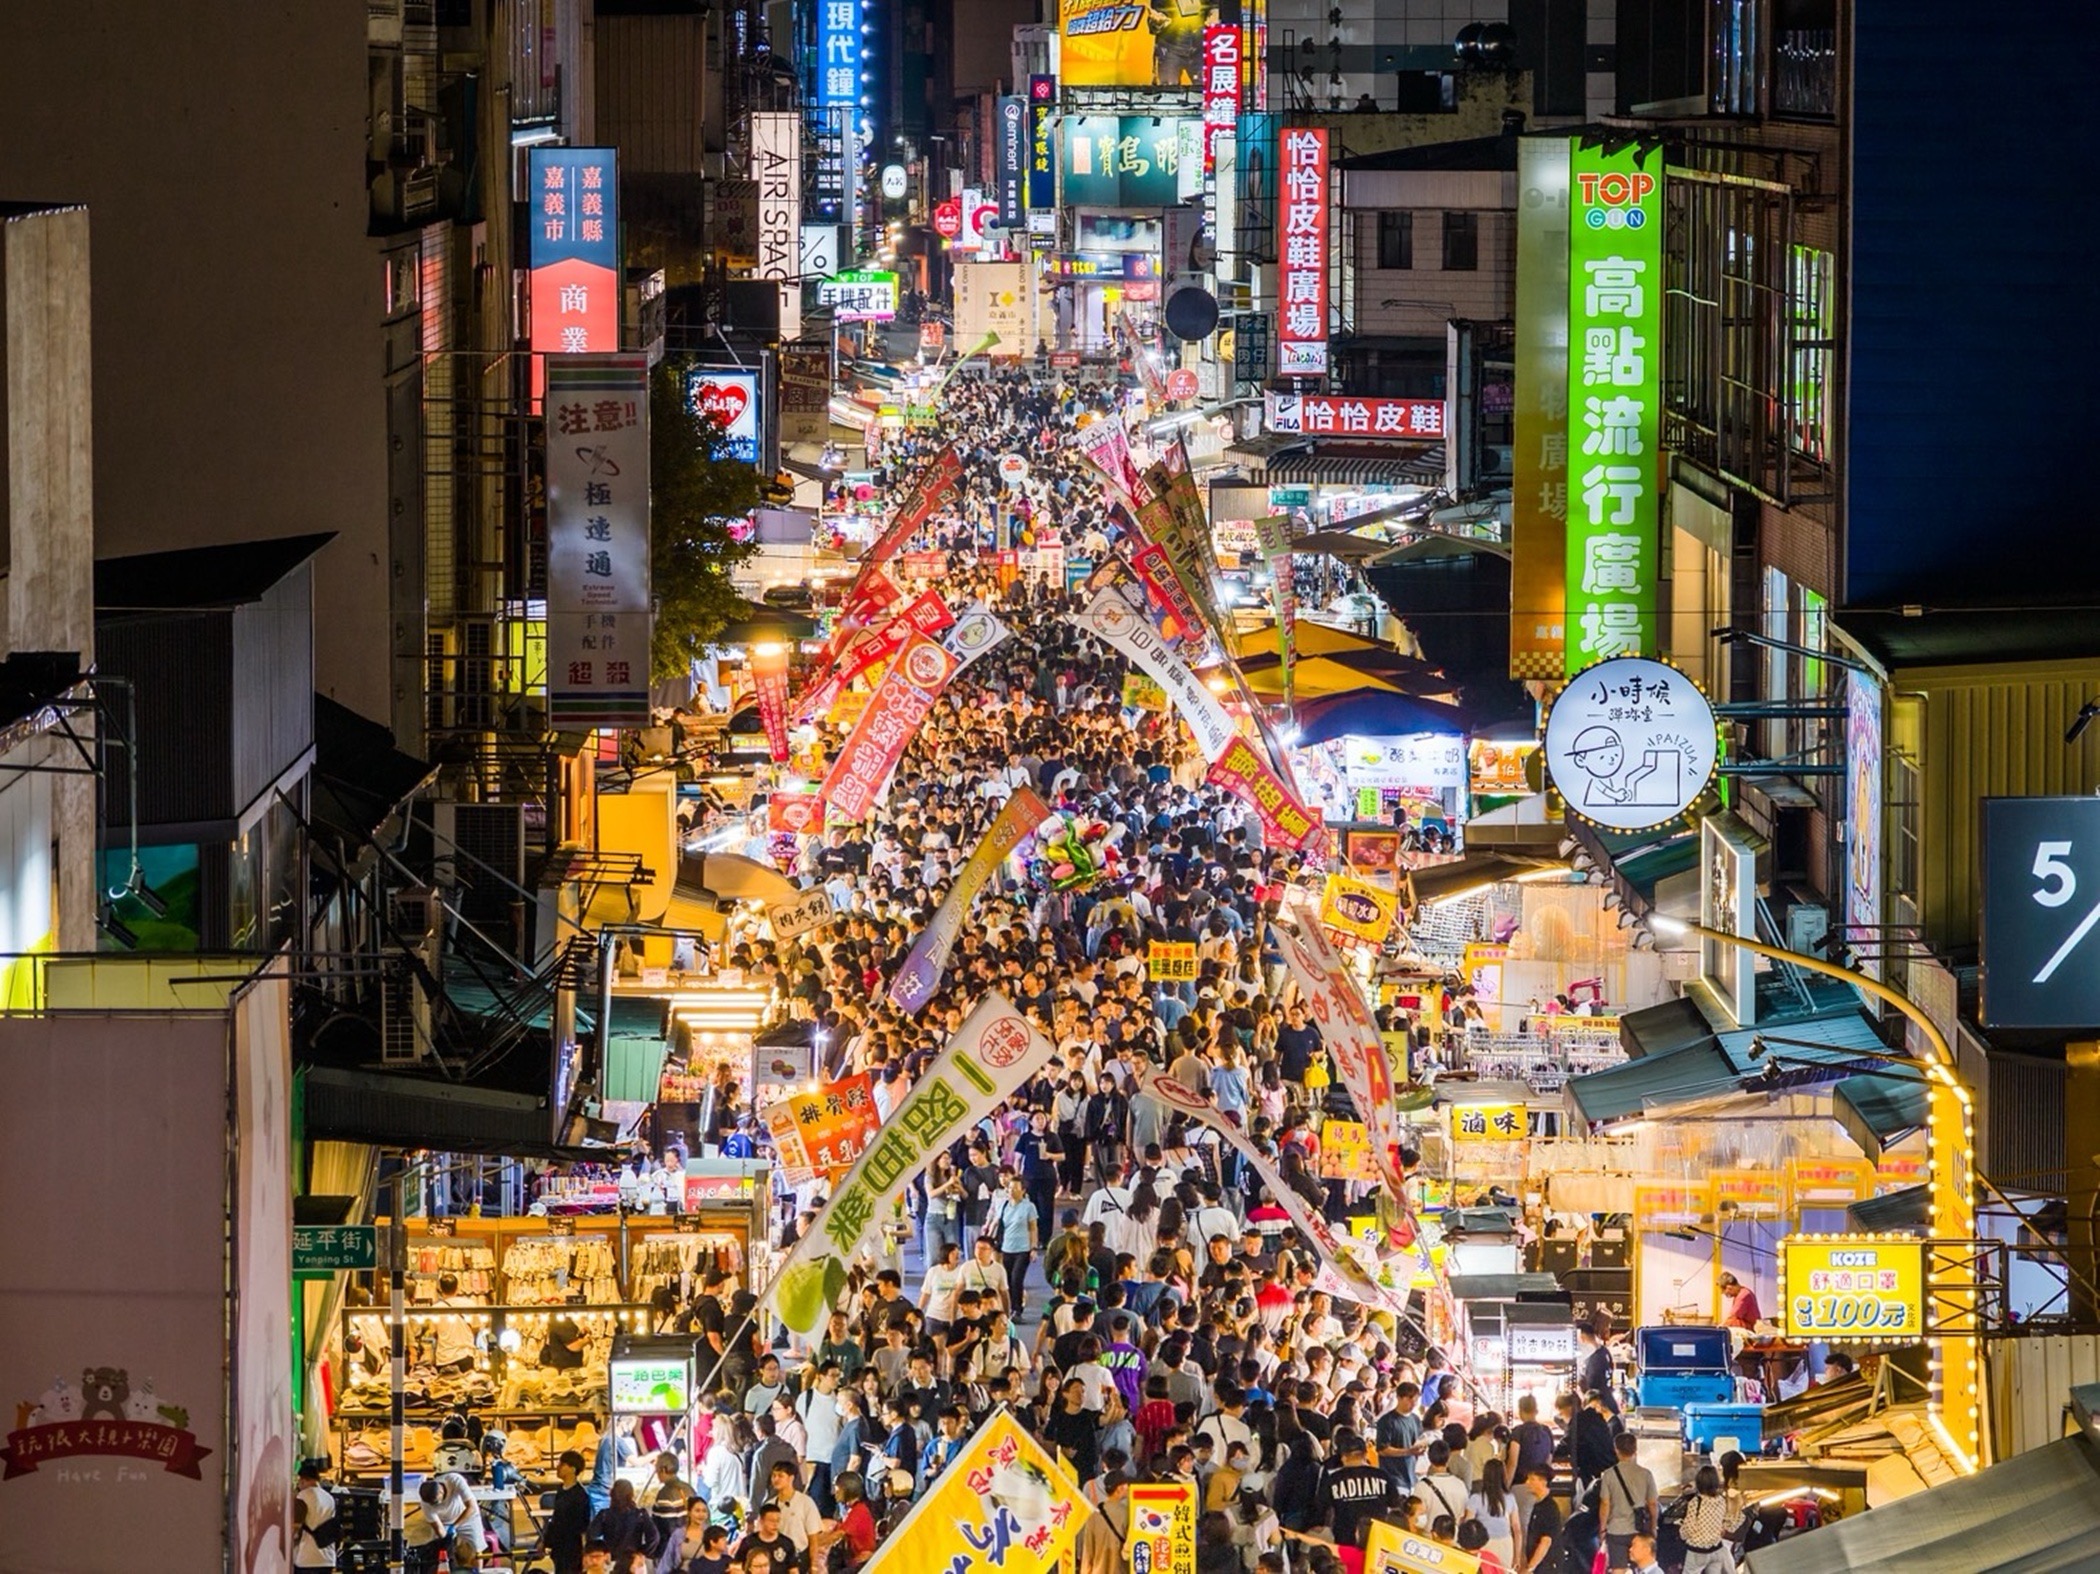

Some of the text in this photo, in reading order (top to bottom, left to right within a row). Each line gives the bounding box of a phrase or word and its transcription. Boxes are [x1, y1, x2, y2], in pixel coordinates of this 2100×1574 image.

[1007, 120, 1019, 171] eminent
[763, 151, 788, 199] AIR
[1577, 172, 1656, 206] TOP
[544, 166, 566, 242] 嘉義市
[581, 166, 603, 242] 嘉義縣
[1588, 210, 1644, 227] GUN
[1286, 130, 1322, 338] 恰恰皮鞋廣場
[822, 287, 890, 310] 手機配件
[1276, 417, 1300, 430] FILA
[1304, 399, 1443, 433] 恰恰皮鞋
[1579, 255, 1645, 657] 高點流行廣場
[584, 481, 613, 578] 極速通
[1591, 675, 1671, 706] 小時候
[799, 1083, 870, 1125] 排骨酥
[1462, 1110, 1521, 1134] 滷味
[292, 1230, 363, 1252] 延平街
[298, 1255, 357, 1266] Yanping St.
[1830, 1251, 1878, 1267] KOZE
[1811, 1271, 1897, 1290] 舒適口罩
[1815, 1296, 1905, 1327] 100元
[57, 1466, 147, 1483] Have Fun
[1331, 1475, 1388, 1500] RADIANT
